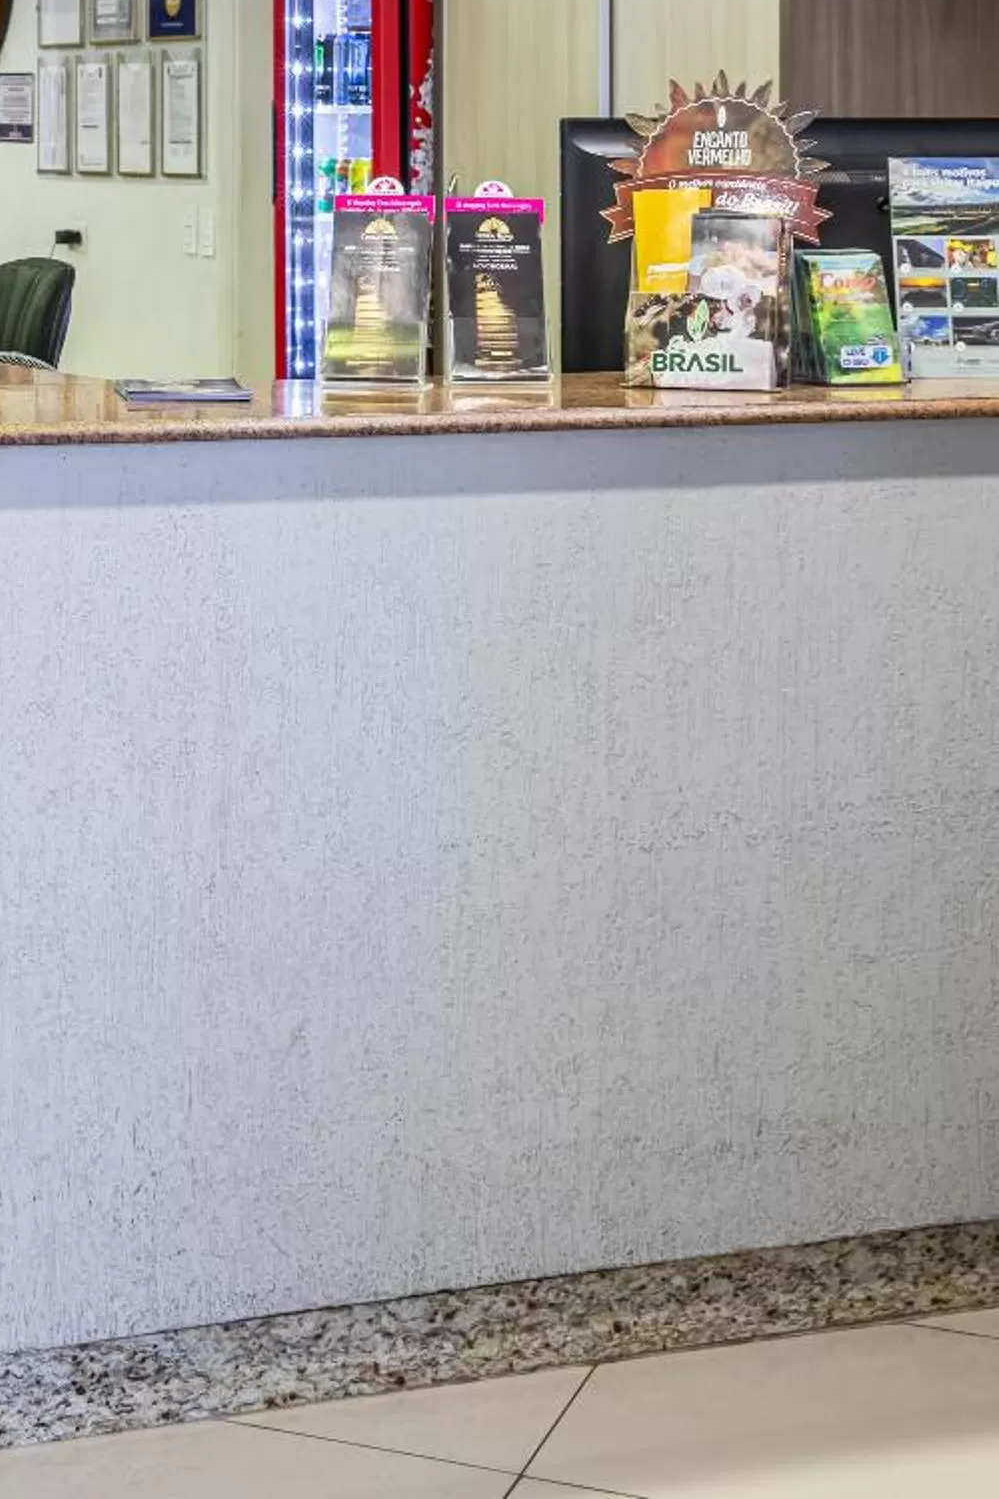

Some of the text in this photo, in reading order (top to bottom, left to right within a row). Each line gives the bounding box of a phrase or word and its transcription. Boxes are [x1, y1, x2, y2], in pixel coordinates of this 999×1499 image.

[693, 130, 748, 149] ENCANTO
[688, 148, 752, 166] VERMELHO
[652, 353, 743, 372] BRASIL
